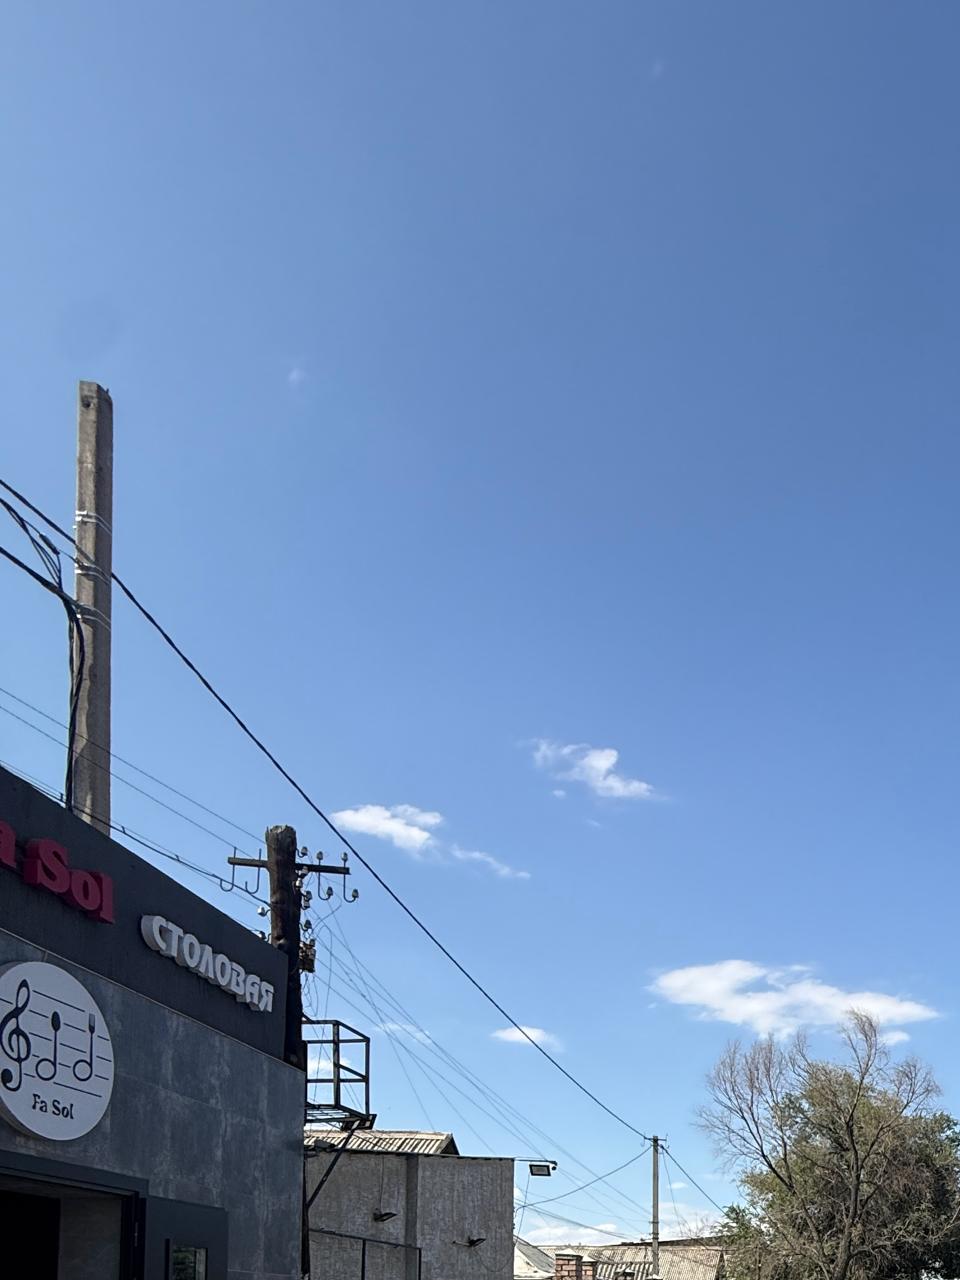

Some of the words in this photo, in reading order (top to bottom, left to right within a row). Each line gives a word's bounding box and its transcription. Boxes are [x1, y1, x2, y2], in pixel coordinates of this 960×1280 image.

[26, 838, 114, 923] Sol
[32, 1093, 48, 1113] Fa
[52, 1099, 74, 1120] Sol
